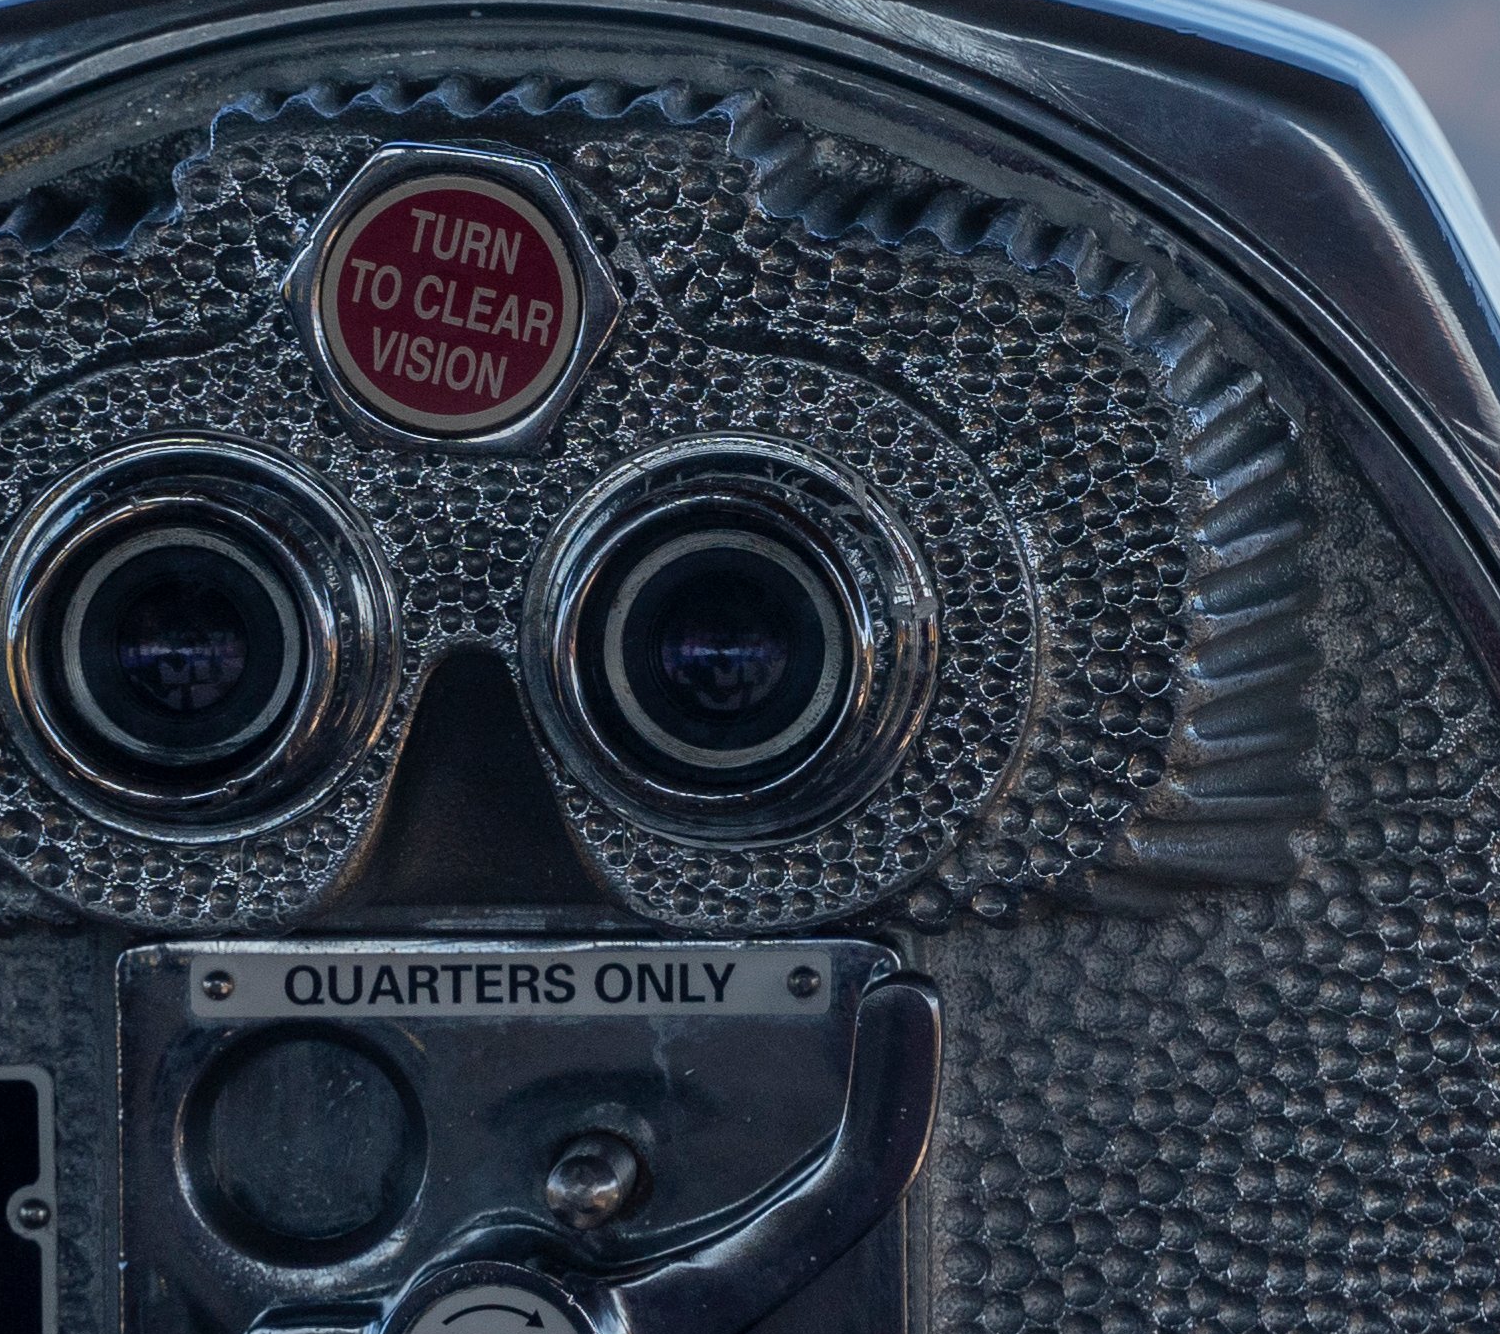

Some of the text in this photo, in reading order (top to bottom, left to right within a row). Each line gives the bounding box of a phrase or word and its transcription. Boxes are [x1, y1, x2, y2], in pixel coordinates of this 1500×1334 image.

[410, 208, 522, 275] TURN
[350, 258, 553, 346] TO CLEAR
[372, 327, 507, 399] VISION
[285, 963, 735, 1005] QUARTERS ONLY
